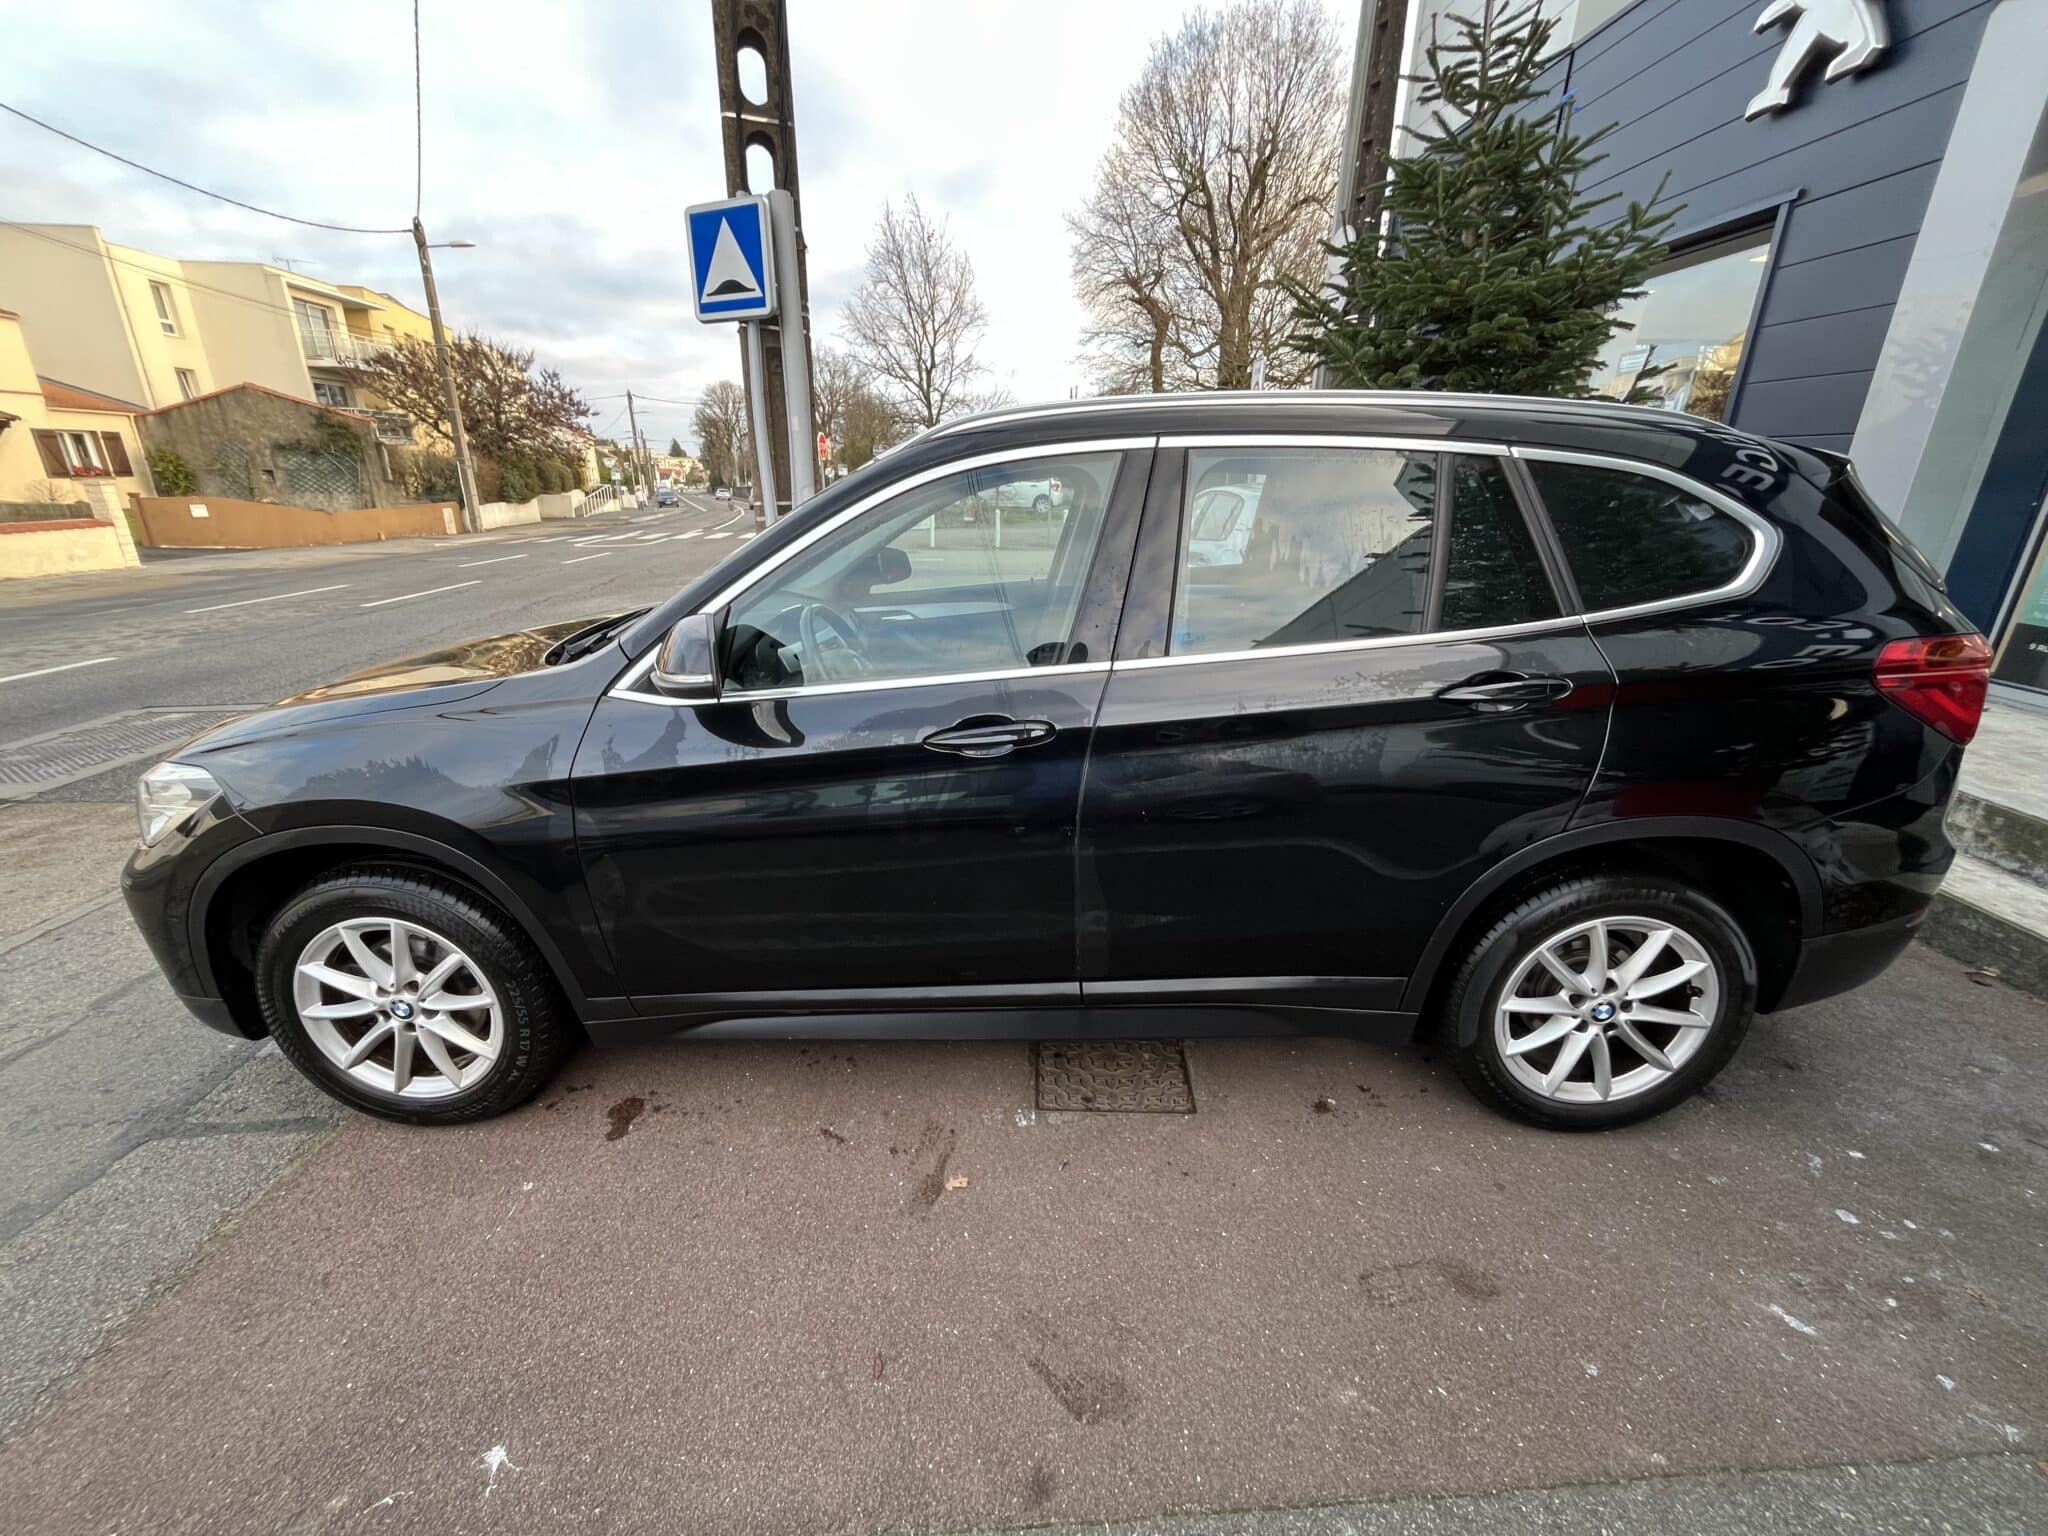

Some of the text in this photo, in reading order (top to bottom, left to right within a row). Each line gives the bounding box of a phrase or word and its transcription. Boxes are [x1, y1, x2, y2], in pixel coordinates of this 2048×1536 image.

[504, 980, 529, 1025] 225/55
[520, 1028, 530, 1037] R
[520, 1041, 530, 1051] 17
